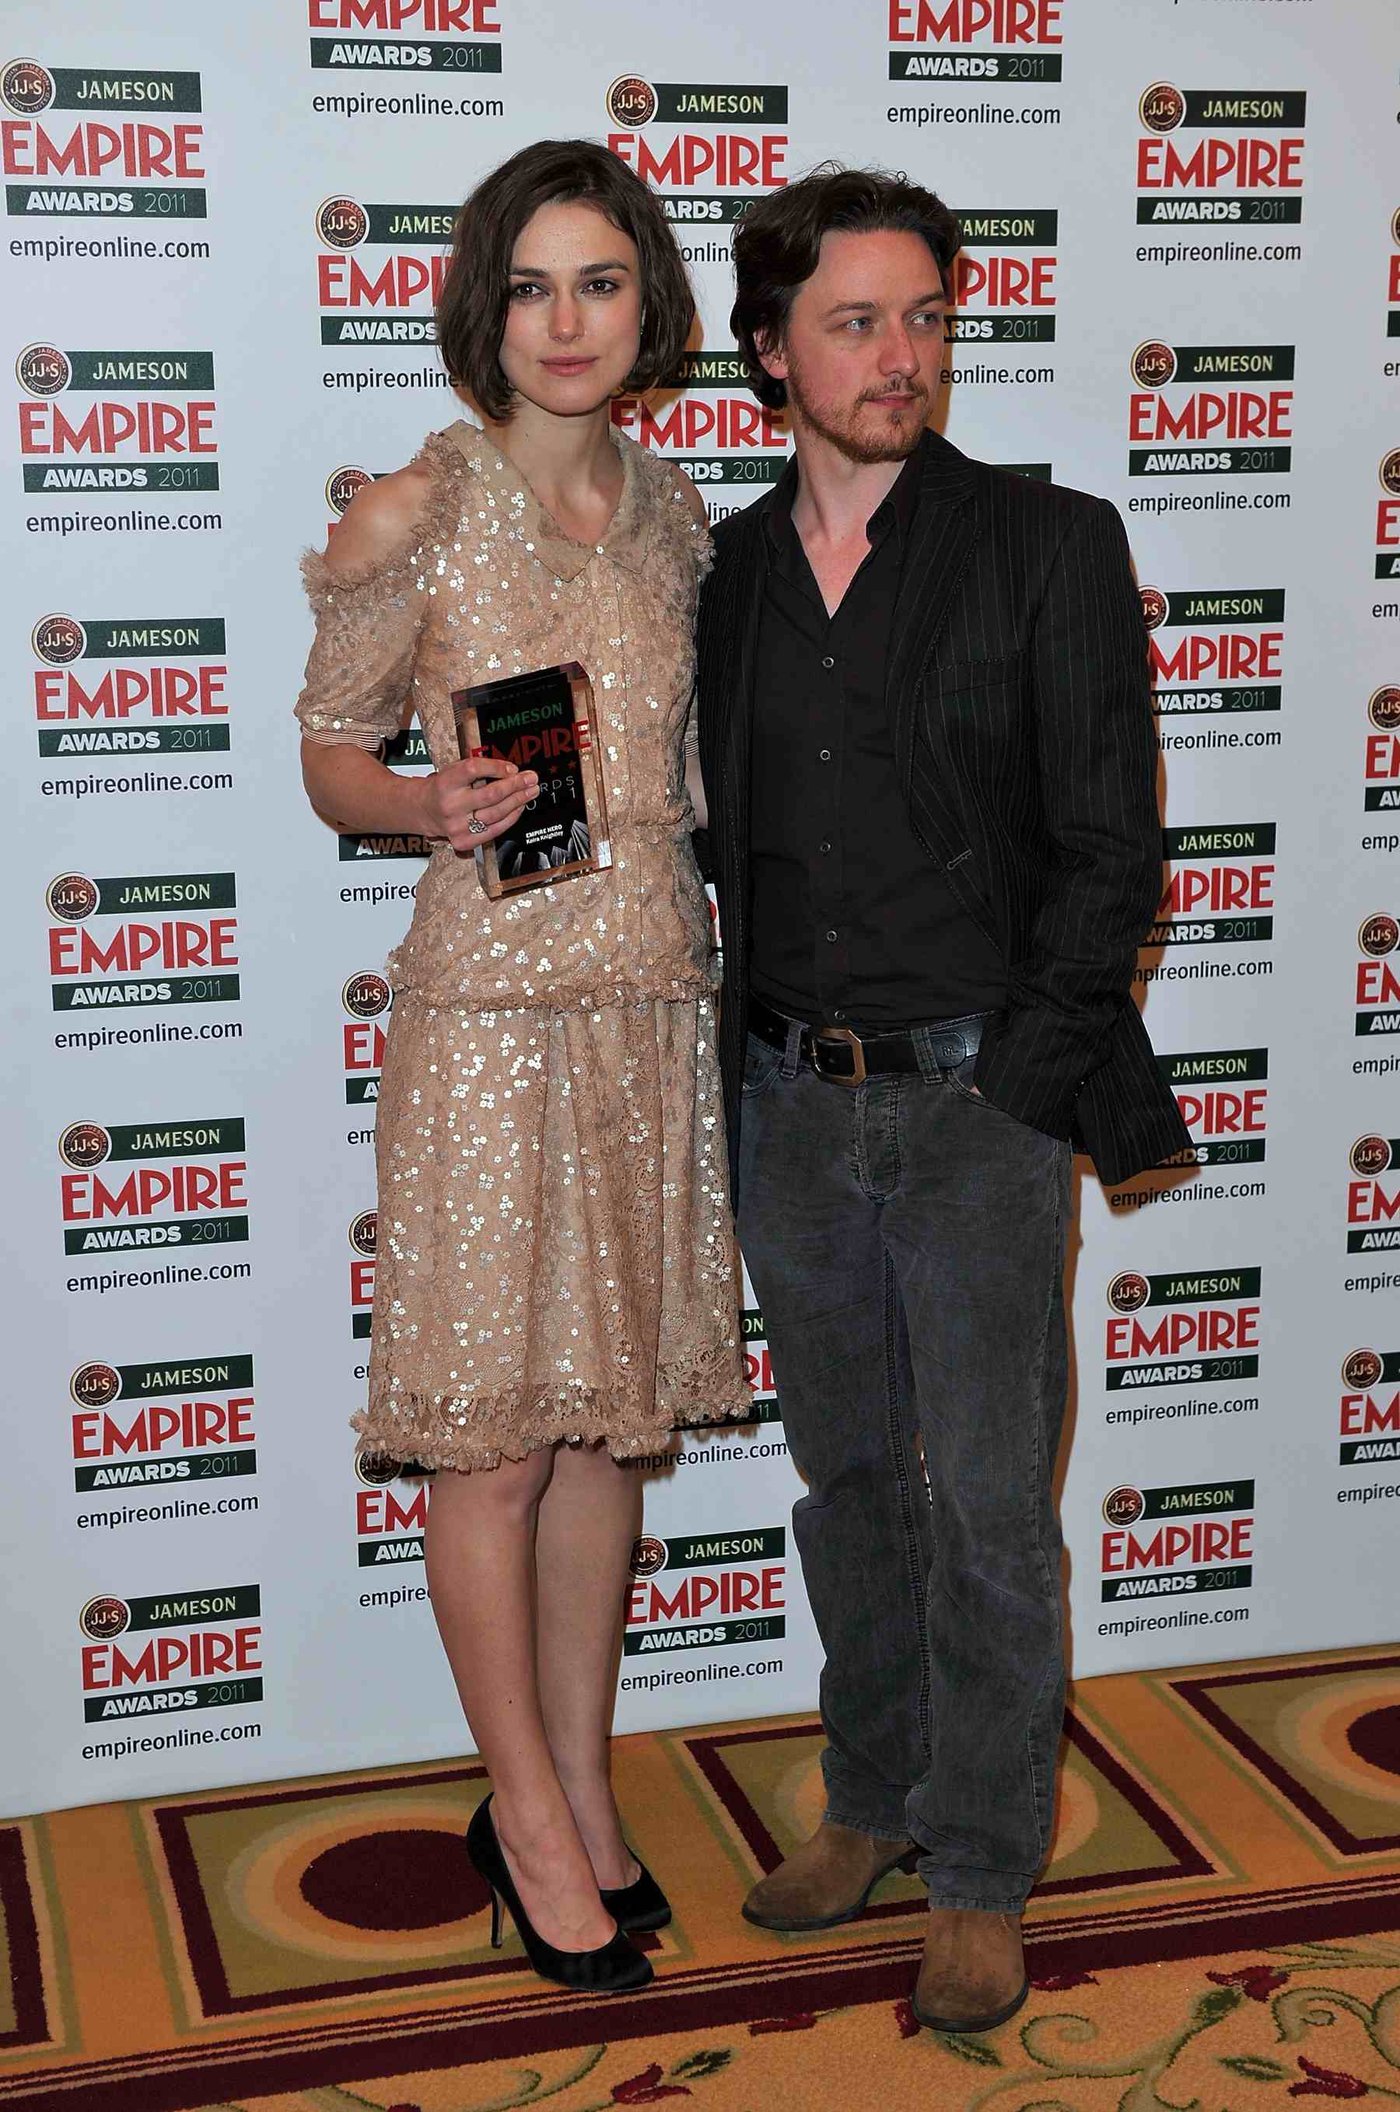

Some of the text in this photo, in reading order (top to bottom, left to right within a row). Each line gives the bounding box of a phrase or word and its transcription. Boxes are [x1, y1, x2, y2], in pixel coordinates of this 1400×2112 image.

[888, 0, 1063, 44] EMPIRE
[330, 45, 482, 67] AWARDS 2011
[905, 57, 1044, 77] AWARDS 2011
[11, 80, 42, 95] JJ&S
[77, 81, 173, 100] JAMESON
[313, 92, 503, 117] empireonline.com
[617, 94, 646, 109] JJ&S
[677, 95, 763, 113] JAMESON
[1148, 99, 1176, 116] JJ&S
[1203, 101, 1283, 118] JAMESON
[888, 103, 1060, 127] empireonline.com
[3, 122, 204, 177] EMPIRE
[1137, 139, 1304, 187] EMPIRE
[26, 192, 185, 213] AWARDS 2011
[665, 200, 723, 219] ARDS
[1152, 201, 1285, 220] AWARDS 2011
[327, 216, 357, 230] JJ&S
[389, 216, 456, 234] JAMES
[959, 219, 1035, 237] AMESON
[10, 236, 209, 261] empireonline.com
[1136, 242, 1300, 265] empireonline.com
[318, 255, 453, 307] EMPI
[1002, 320, 1037, 338] 2011
[28, 363, 59, 377] JJ&S
[93, 362, 187, 380] JAMESON
[940, 364, 1054, 384] eonline.com
[1140, 357, 1168, 373] JJ&S
[1194, 356, 1272, 372] JAMESON
[323, 368, 459, 392] empireonline
[1130, 391, 1293, 440] EMPIRE
[21, 403, 217, 452] EMPIRE
[733, 462, 769, 479] 2011
[1144, 451, 1274, 471] AWARDS 2011
[43, 468, 198, 487] AWARDS 2011
[1129, 492, 1290, 515] empireonline.com
[27, 511, 221, 536] empireonline.com
[1186, 599, 1263, 616] JAMESON
[44, 632, 74, 647] JJ&S
[107, 629, 199, 647] JAMESON
[1150, 633, 1284, 682] MPIRE
[36, 667, 228, 719] EMPIRE
[1154, 691, 1264, 711] WARDS 2011
[487, 702, 564, 734] JAMESON
[58, 729, 210, 751] AWARDS 2011
[1157, 730, 1282, 750] ireonline.com
[42, 773, 232, 799] empireonline.com
[540, 776, 575, 793] RDS
[1178, 833, 1254, 851] JAMESON
[58, 890, 87, 905] JJ&S
[120, 884, 210, 903] JAMESON
[1224, 921, 1256, 939] 2011
[50, 919, 237, 974] EMPIRE
[71, 980, 220, 1005] AWARDS 2011
[353, 988, 381, 1002] JJ&S
[55, 1023, 242, 1050] empireonline.com
[1172, 1058, 1246, 1077] JAMESON
[1177, 1089, 1268, 1135] PIRE
[70, 1138, 100, 1152] JJ&S
[131, 1129, 219, 1150] JAMESON
[1217, 1144, 1249, 1161] 2011
[62, 1163, 246, 1220] EMPIRE
[1111, 1182, 1265, 1209] empireonline.com
[83, 1222, 229, 1249] AWARDS 2011
[1361, 1231, 1400, 1249] AWA
[67, 1264, 250, 1293] empireonline.com
[1166, 1277, 1240, 1296] JAMESON
[1115, 1285, 1141, 1299] JJ&S
[1107, 1308, 1259, 1359] EMPIRE
[141, 1366, 228, 1388] JAMESON
[1121, 1360, 1242, 1385] AWARDS 2011
[81, 1378, 111, 1392] JJ&S
[1106, 1399, 1258, 1425] empireonline.com
[73, 1398, 255, 1458] EMPIRE
[93, 1456, 237, 1486] AWARDS 2011
[1111, 1499, 1137, 1513] JJ&S
[1161, 1490, 1234, 1509] JAMESON
[77, 1497, 258, 1529] empireonline.com
[375, 1541, 424, 1561] AWA
[685, 1538, 763, 1559] JAMESON
[1102, 1519, 1252, 1571] EMPIRE
[1116, 1571, 1237, 1597] AWARDS 2011
[624, 1567, 786, 1625] EMPIRE
[91, 1610, 119, 1625] JJ&S
[150, 1596, 235, 1620] JAMESON
[1098, 1609, 1248, 1636] empireonline.com
[639, 1621, 768, 1650] AWARDS 2011
[83, 1628, 260, 1689] EMPIRE
[621, 1660, 782, 1691] empireonline.com
[102, 1684, 244, 1716] AWARDS 2011
[82, 1724, 260, 1759] empireonline.com
